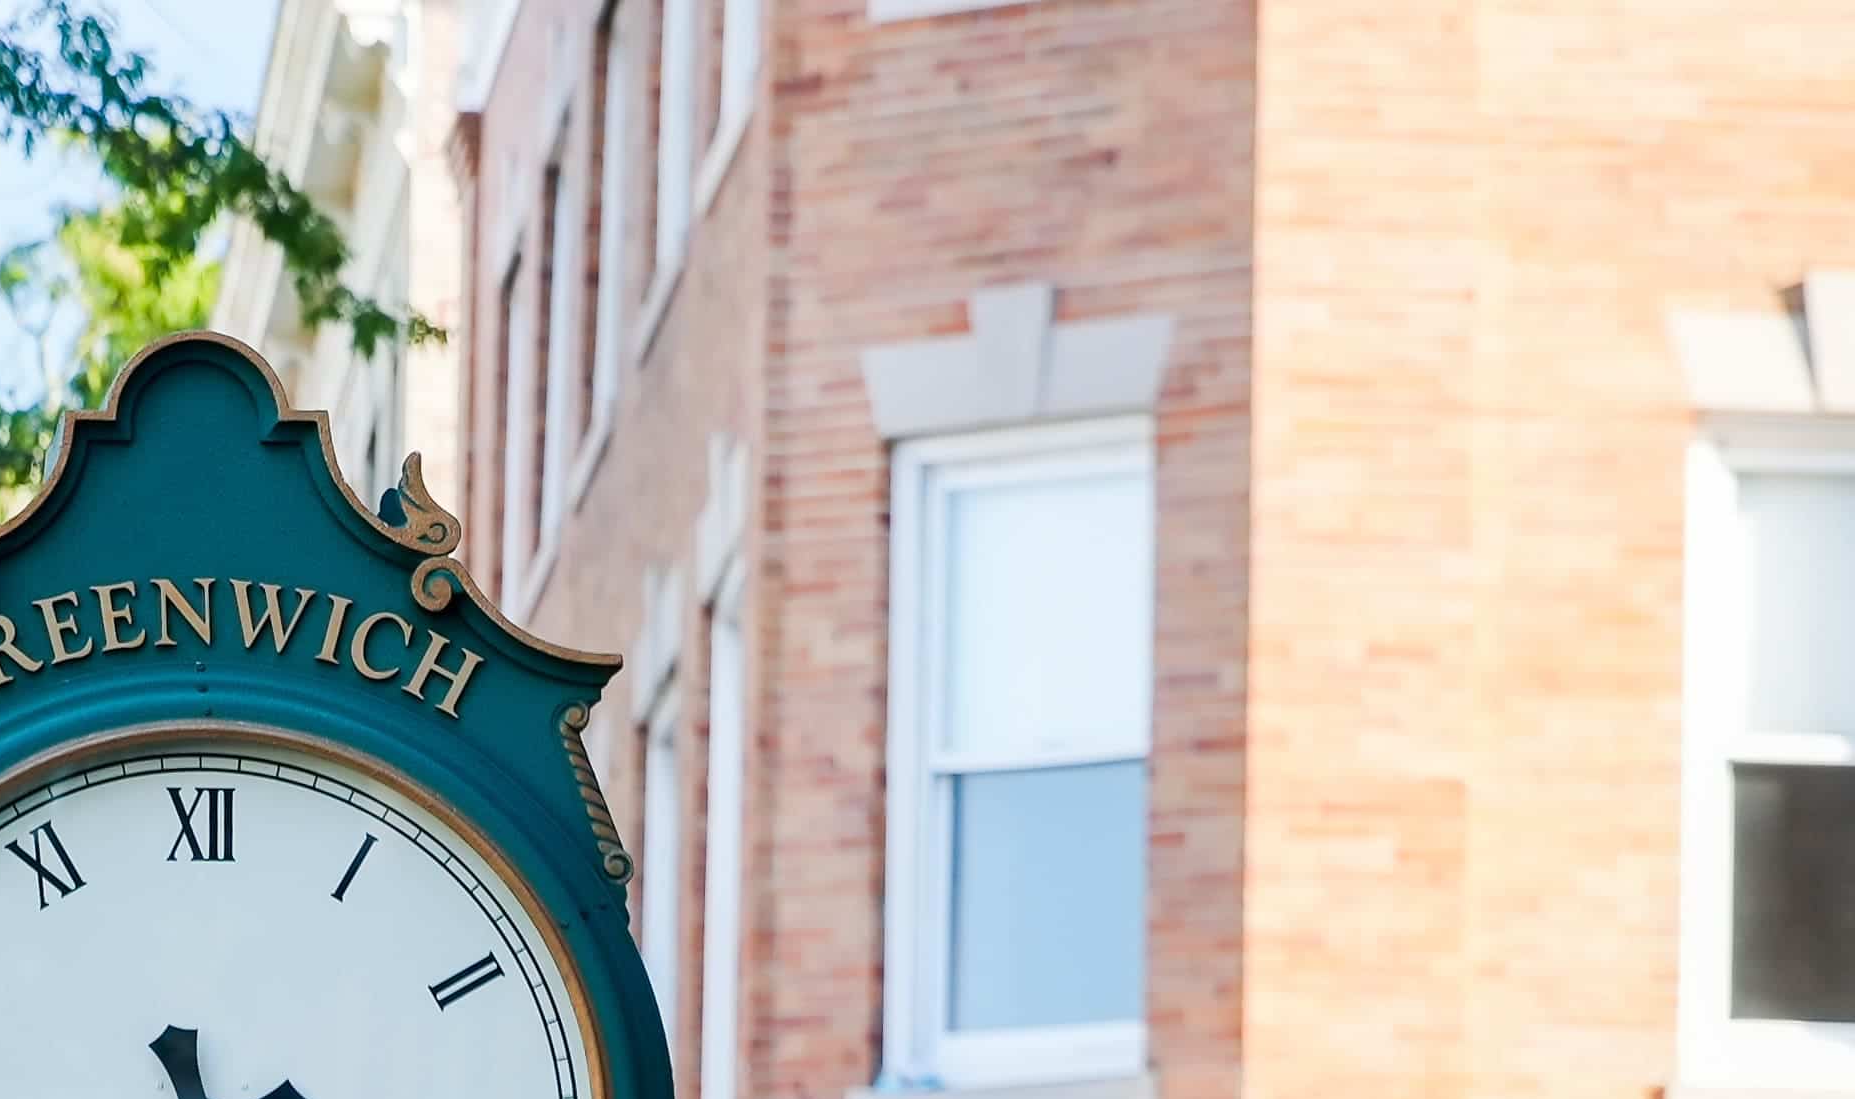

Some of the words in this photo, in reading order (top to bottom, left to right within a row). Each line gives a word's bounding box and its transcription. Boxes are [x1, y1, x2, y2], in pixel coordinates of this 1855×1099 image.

[166, 786, 236, 862] XII
[4, 820, 87, 910] XI
[330, 832, 380, 903] I
[427, 950, 506, 1012] II
